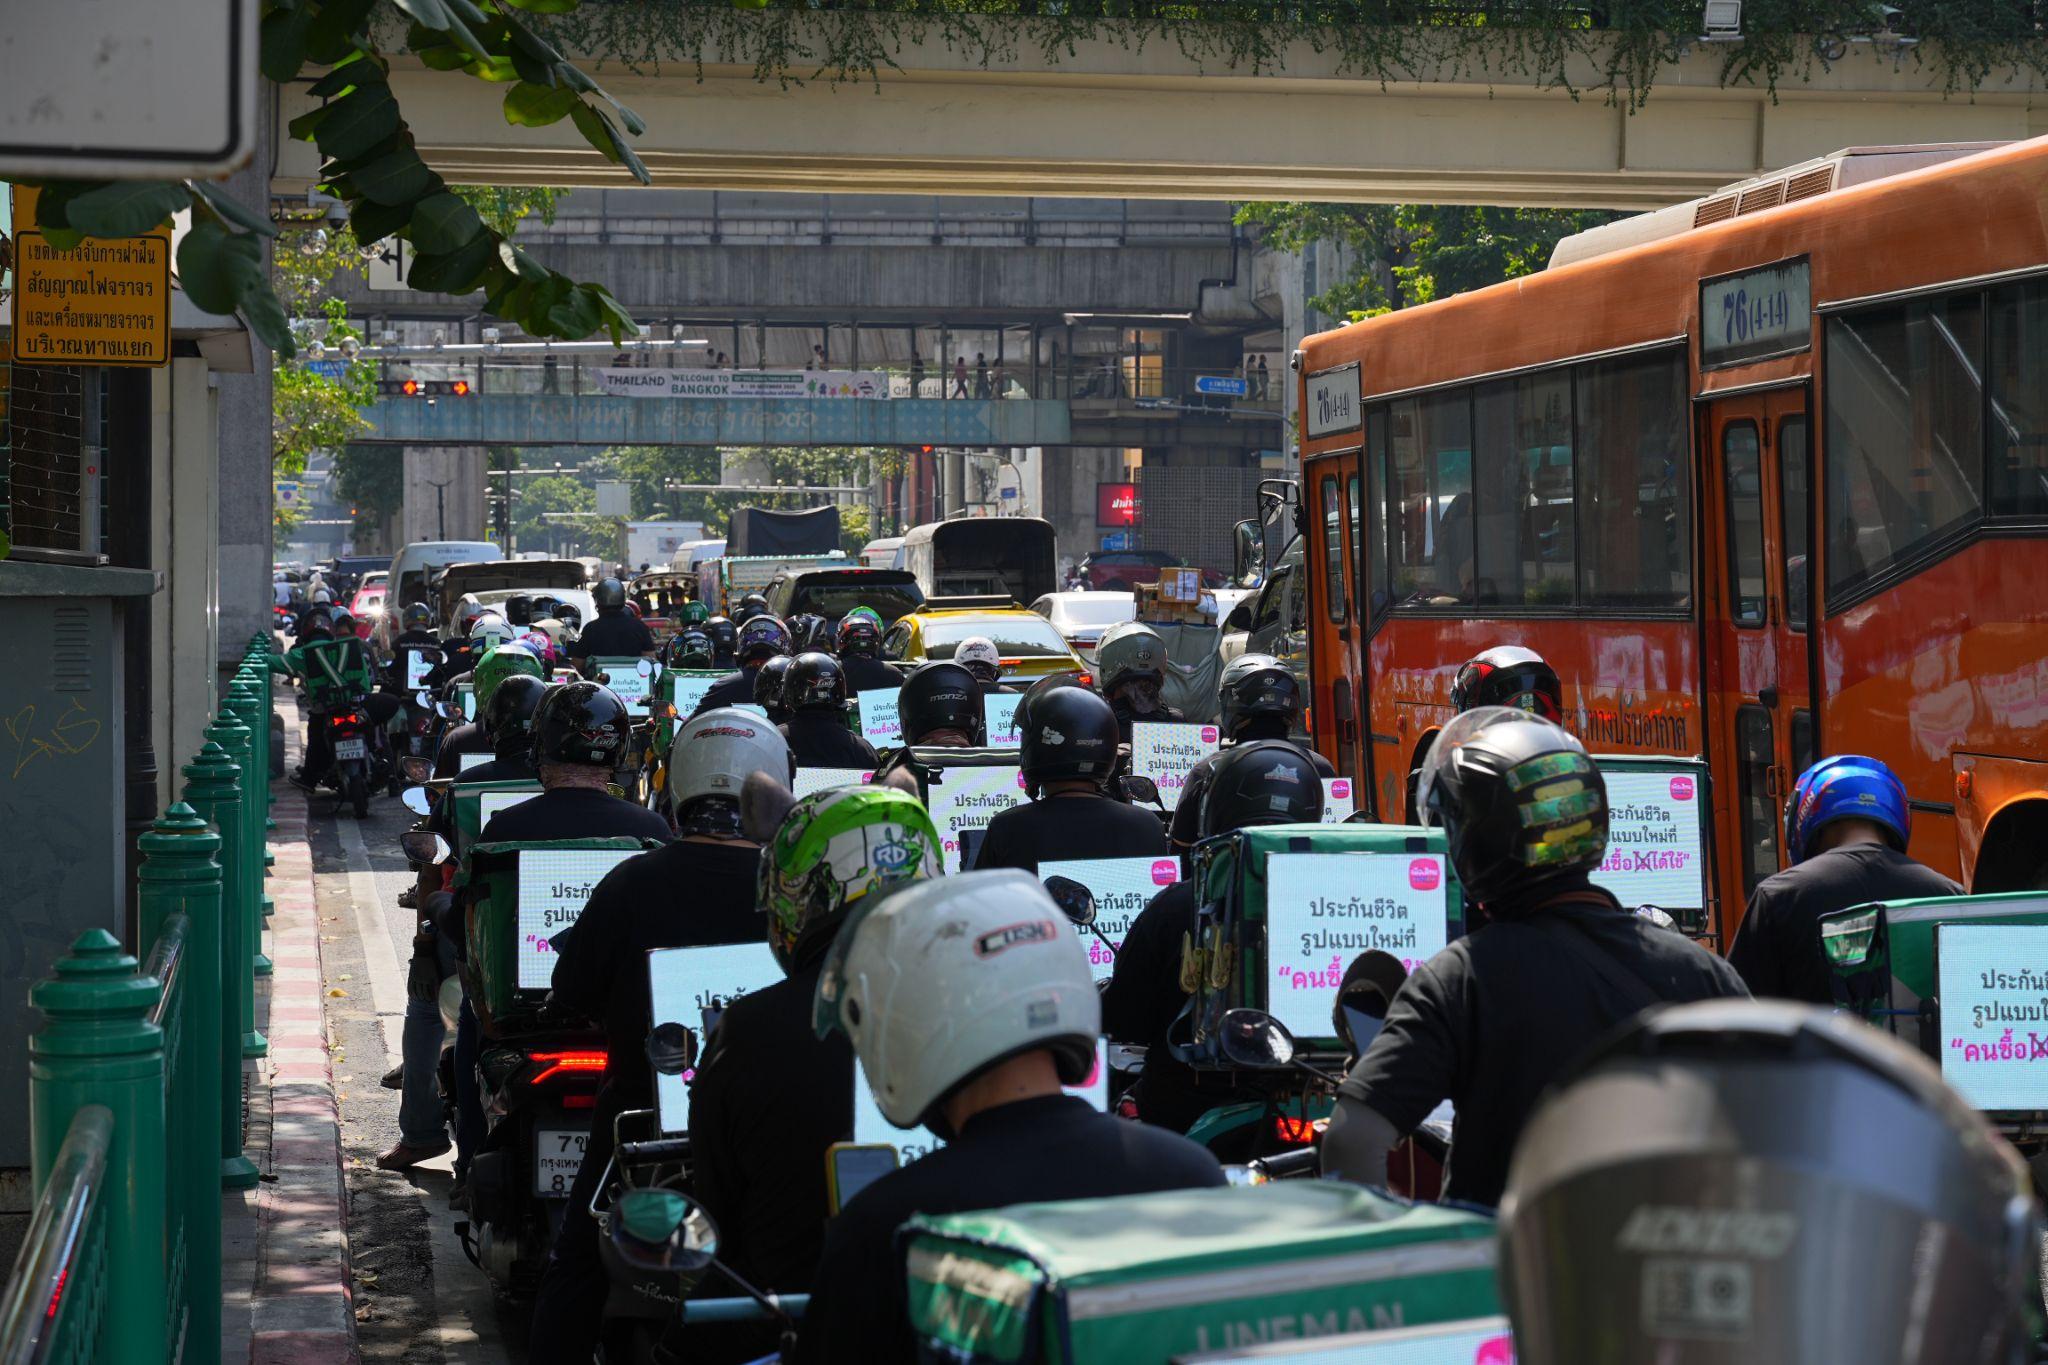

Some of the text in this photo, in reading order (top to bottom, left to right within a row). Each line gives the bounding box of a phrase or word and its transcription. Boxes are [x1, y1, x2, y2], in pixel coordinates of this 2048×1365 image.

[28, 270, 153, 298] สัญญาณไฟจราจร
[26, 302, 155, 330] และเครื่องหมายจราจร
[26, 333, 153, 356] บริเวณทางแยก
[607, 375, 665, 387] THAILAND
[671, 374, 714, 383] WELCOME
[671, 384, 729, 395] BANGKOK
[955, 792, 1018, 808] ประกันชีวิต
[1608, 803, 1671, 822] ระกันชีวิต
[877, 845, 907, 865] RD
[1310, 896, 1409, 920] ประกันชีวิต
[1300, 923, 1417, 957] รูปแบบใหม่ที่
[541, 1158, 583, 1172] กรุงเทพ
